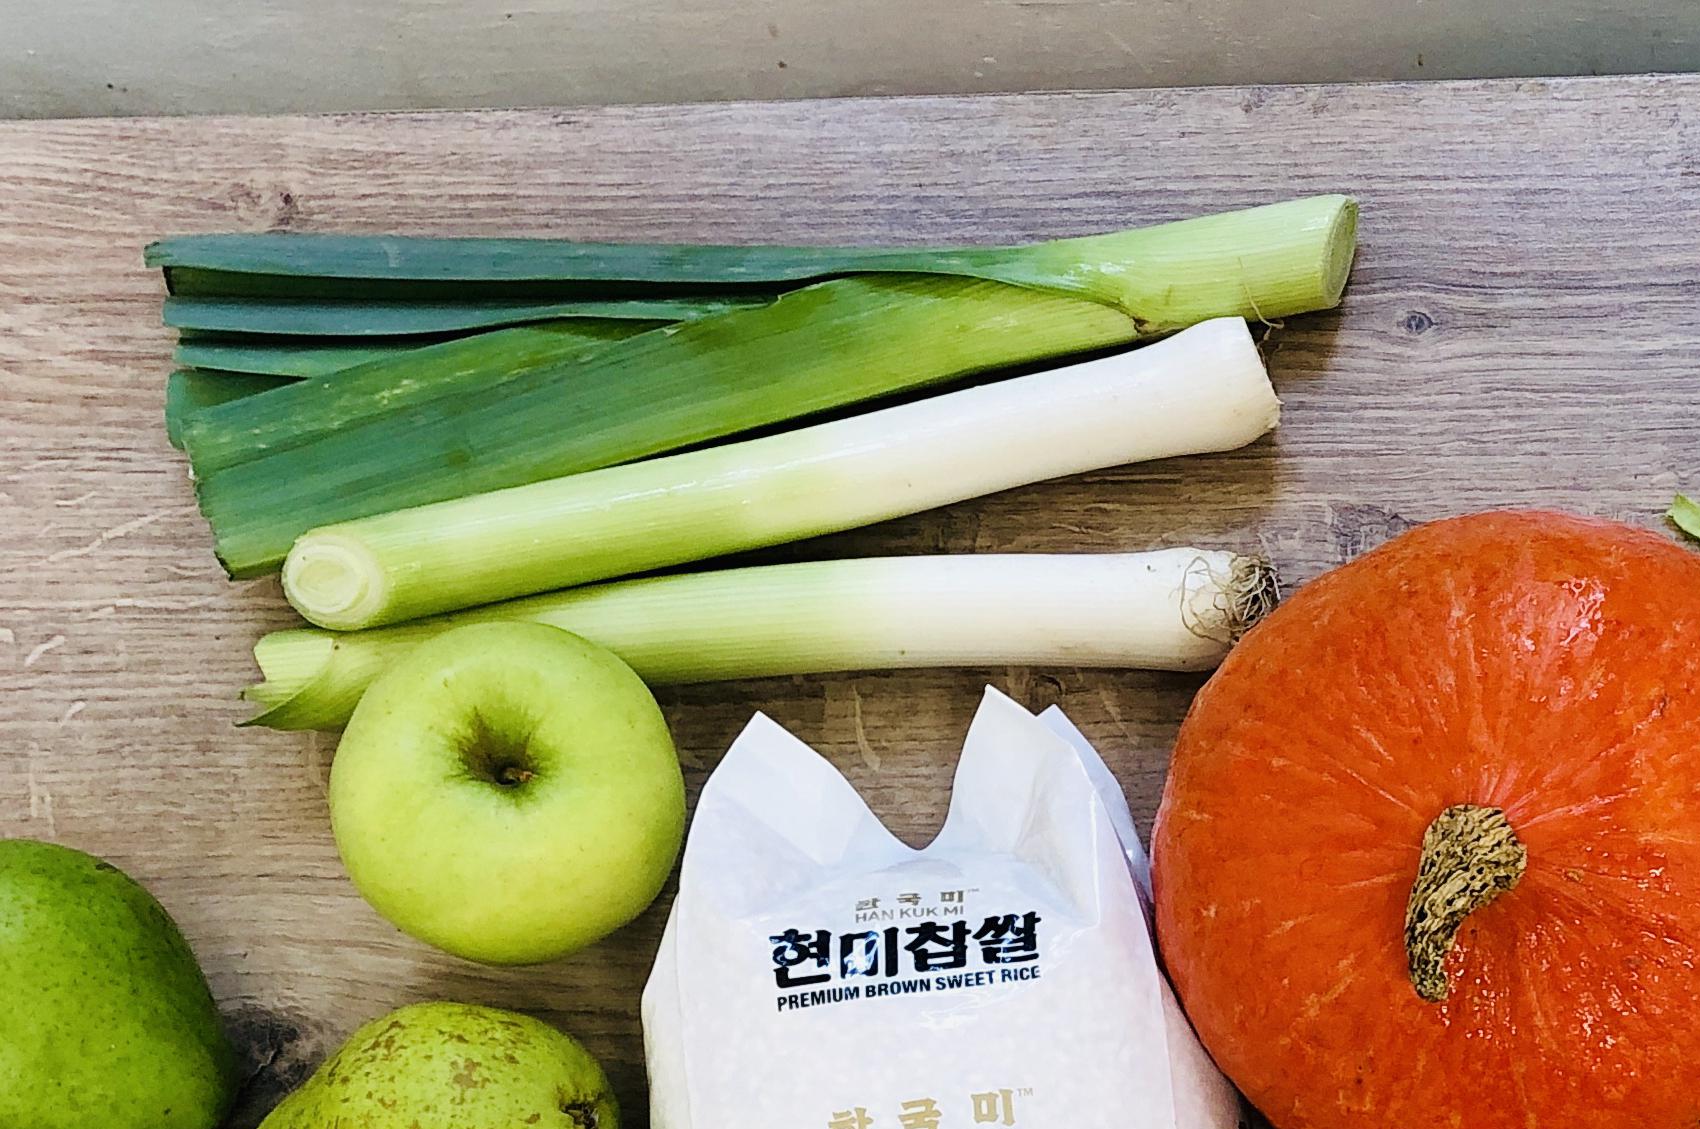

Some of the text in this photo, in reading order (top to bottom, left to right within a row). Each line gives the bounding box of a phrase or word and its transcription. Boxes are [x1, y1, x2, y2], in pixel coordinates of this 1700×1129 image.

[855, 905, 964, 923] HAN KUK MI
[769, 911, 1041, 989] 현미찹쌀
[777, 965, 1041, 1012] PREMIUM BROWN SWEET RICE
